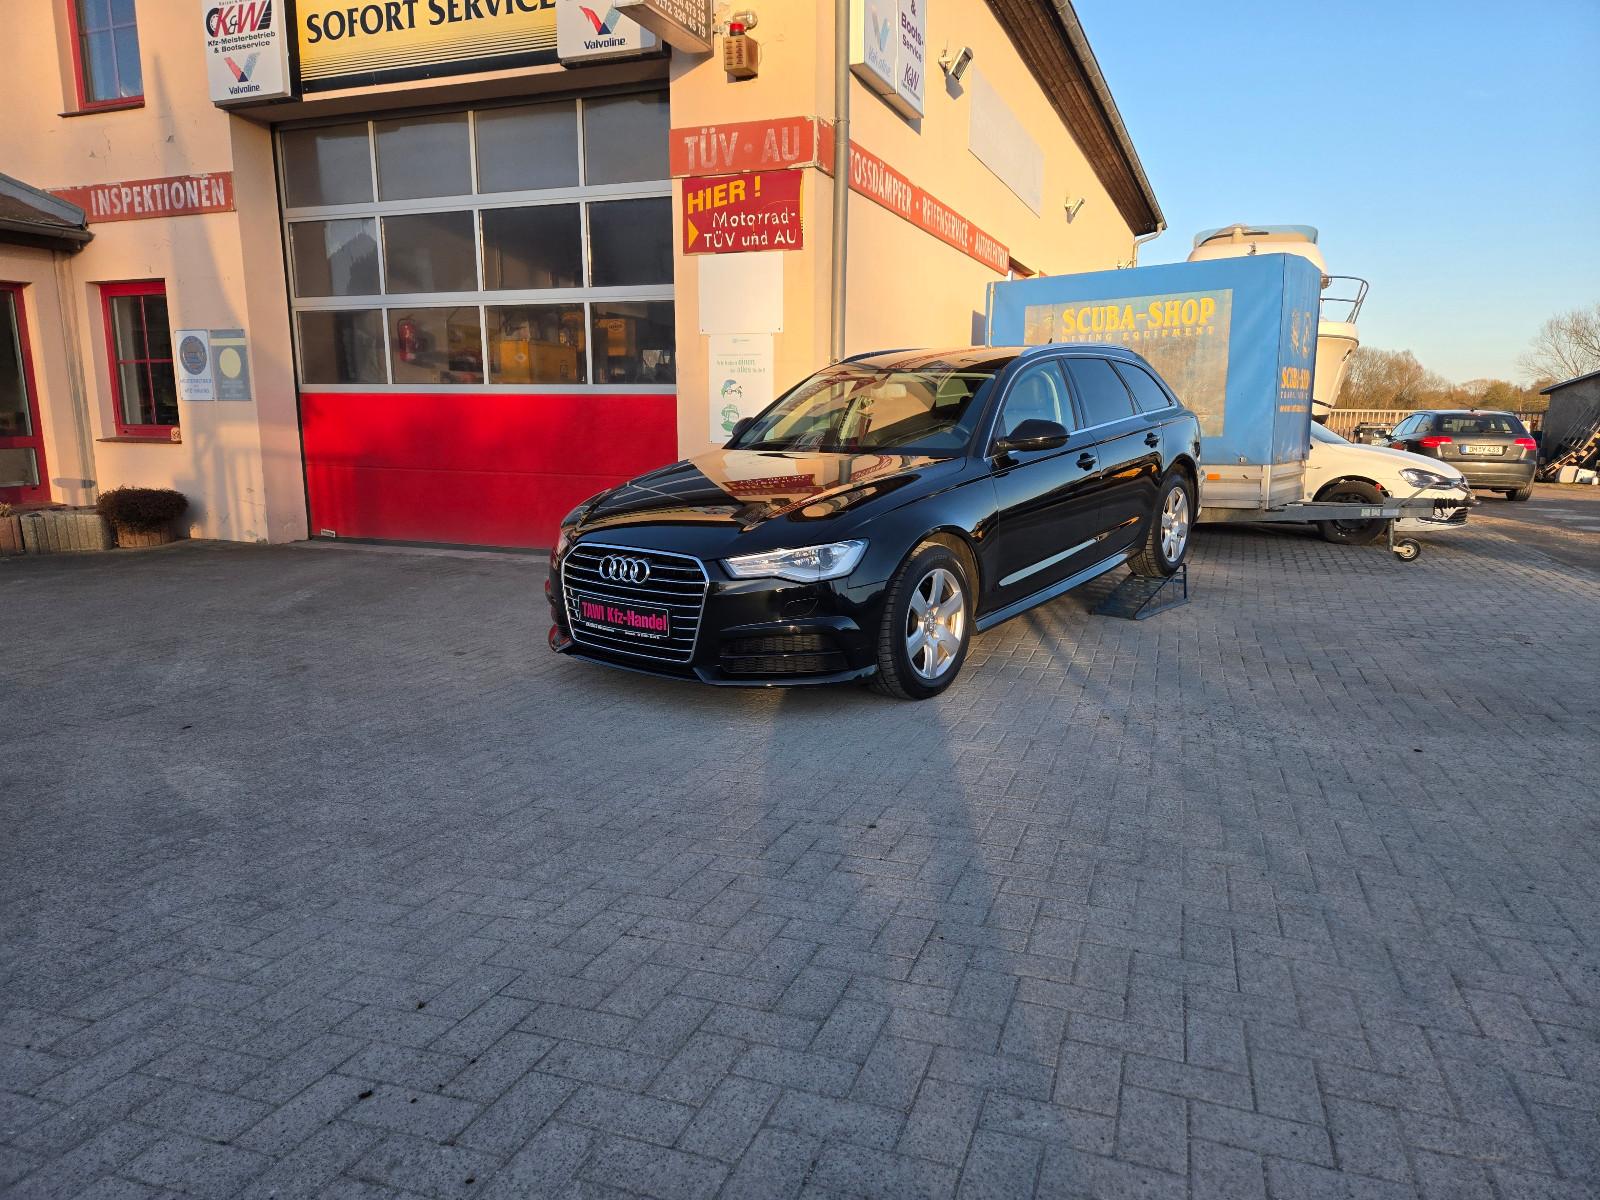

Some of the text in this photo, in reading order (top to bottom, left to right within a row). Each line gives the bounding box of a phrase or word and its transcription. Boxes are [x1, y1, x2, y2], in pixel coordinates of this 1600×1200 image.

[306, 0, 419, 44] SOFORT
[697, 22, 706, 38] 79
[207, 31, 276, 47] Kfz-Meisterbetrieb
[221, 40, 271, 53] Bootsservice
[583, 37, 627, 50] Valvoline
[902, 34, 922, 63] Service
[228, 83, 261, 96] Valvoline
[684, 126, 800, 170] TÜV AU
[89, 177, 227, 217] INSPEKTIONEN
[687, 179, 746, 215] HIER
[848, 147, 912, 217] TOSSDÄMPFER
[922, 195, 969, 248] REIFENSERVICE
[712, 207, 796, 228] Motorrad-
[703, 229, 798, 248] TÜV und AU
[1061, 297, 1216, 335] SCUBA-SHOP
[1122, 325, 1215, 342] EQUIPMENT
[607, 606, 668, 631] Kfz-Handel
